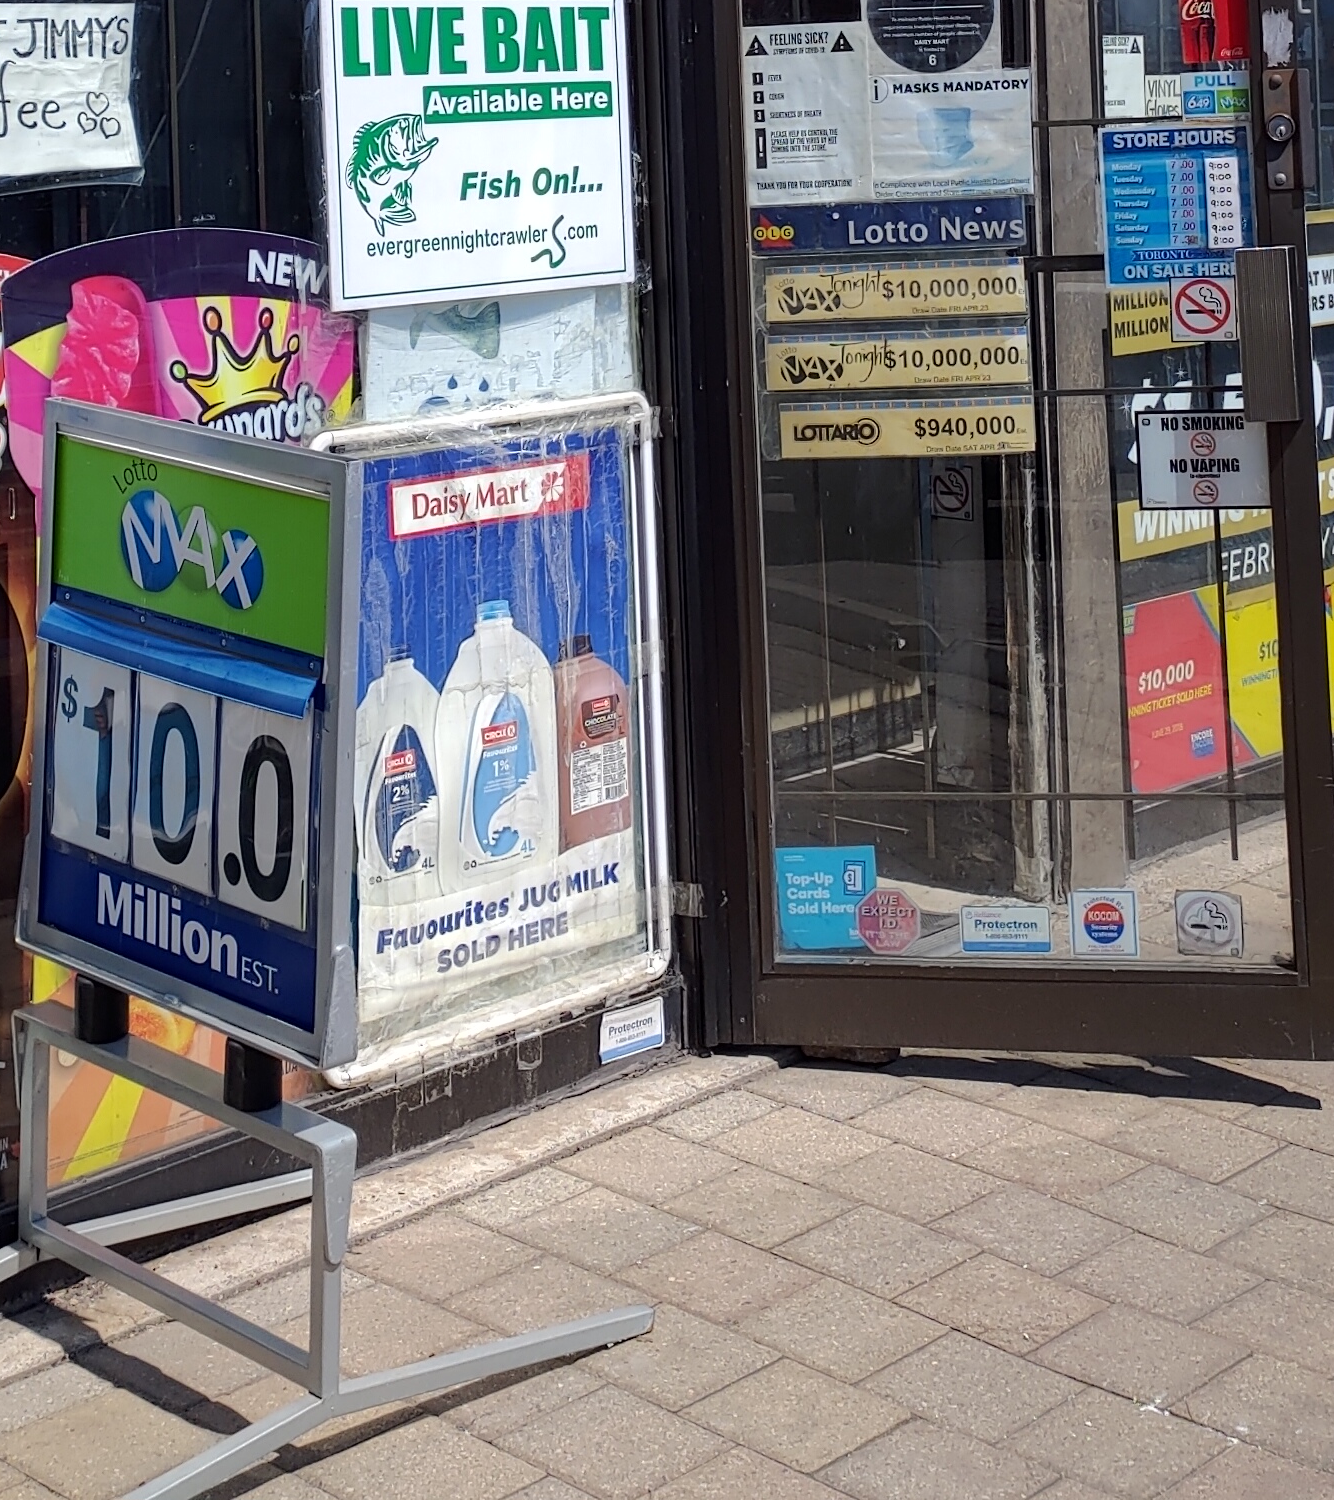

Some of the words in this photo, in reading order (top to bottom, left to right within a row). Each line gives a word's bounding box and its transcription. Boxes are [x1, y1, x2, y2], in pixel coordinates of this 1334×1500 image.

[341, 6, 465, 77] LIVE
[483, 6, 610, 73] BAIT
[770, 32, 802, 46] FEELING
[804, 31, 828, 45] SICK?
[892, 82, 939, 94] MASKS
[943, 79, 1029, 93] MANDATORY
[1148, 79, 1180, 98] VINYL
[1194, 75, 1236, 88] PULL
[426, 87, 543, 117] Available
[550, 86, 609, 112] Here
[1113, 132, 1170, 149] STORE
[1174, 129, 1236, 146] HOURS
[459, 169, 522, 203] Fish
[847, 219, 928, 246] Lotto
[940, 216, 1025, 241] News
[248, 248, 330, 296] NEW
[1123, 265, 1149, 279] ON
[1152, 263, 1194, 278] SALE
[881, 276, 1018, 302] $10,000,000
[1113, 289, 1169, 312] MILLION
[1114, 316, 1168, 339] MILLION
[884, 346, 1019, 372] $10,000,000
[793, 418, 880, 445] LOTTARIO
[914, 415, 1016, 441] $940,000
[1160, 417, 1179, 431] NO
[1181, 415, 1244, 431] SMOKING
[1169, 459, 1188, 473] NO
[1190, 458, 1240, 473] VAPING
[113, 459, 158, 495] Lotto
[411, 491, 467, 523] Daisy
[473, 478, 529, 509] Mart
[122, 490, 259, 611] MAX
[1138, 660, 1195, 695] $10,000
[492, 759, 510, 778] 1%
[392, 784, 410, 803] 2%
[520, 838, 536, 853] 4L
[422, 856, 435, 870] 4L
[785, 872, 834, 887] Top-Up
[786, 887, 831, 899] Cards
[877, 893, 898, 905] WE
[375, 897, 510, 955] Favourites
[516, 878, 561, 914] JUG
[565, 861, 620, 894] MILK
[788, 901, 818, 915] Sold
[821, 901, 855, 914] Here
[861, 906, 915, 917] EXPECT
[95, 873, 238, 981] Million
[241, 957, 280, 996] EST.
[974, 919, 1038, 930] Protectron
[436, 935, 502, 974] SOLD
[507, 913, 569, 947] HERE
